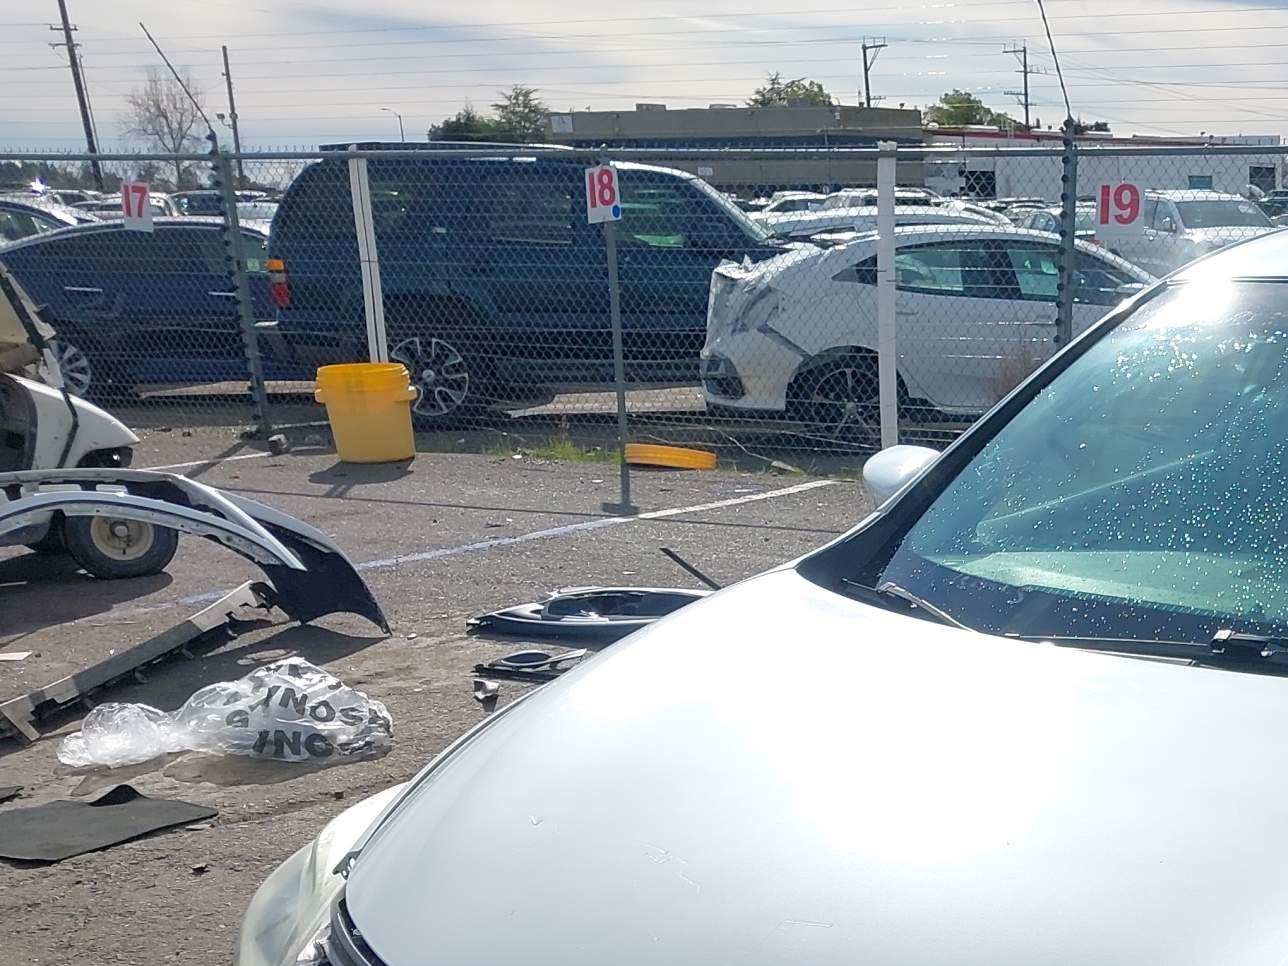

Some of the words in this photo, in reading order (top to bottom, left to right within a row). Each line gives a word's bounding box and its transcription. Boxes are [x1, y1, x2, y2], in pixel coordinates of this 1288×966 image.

[123, 184, 147, 218] 17
[588, 169, 616, 208] 18
[1100, 183, 1140, 225] 19
